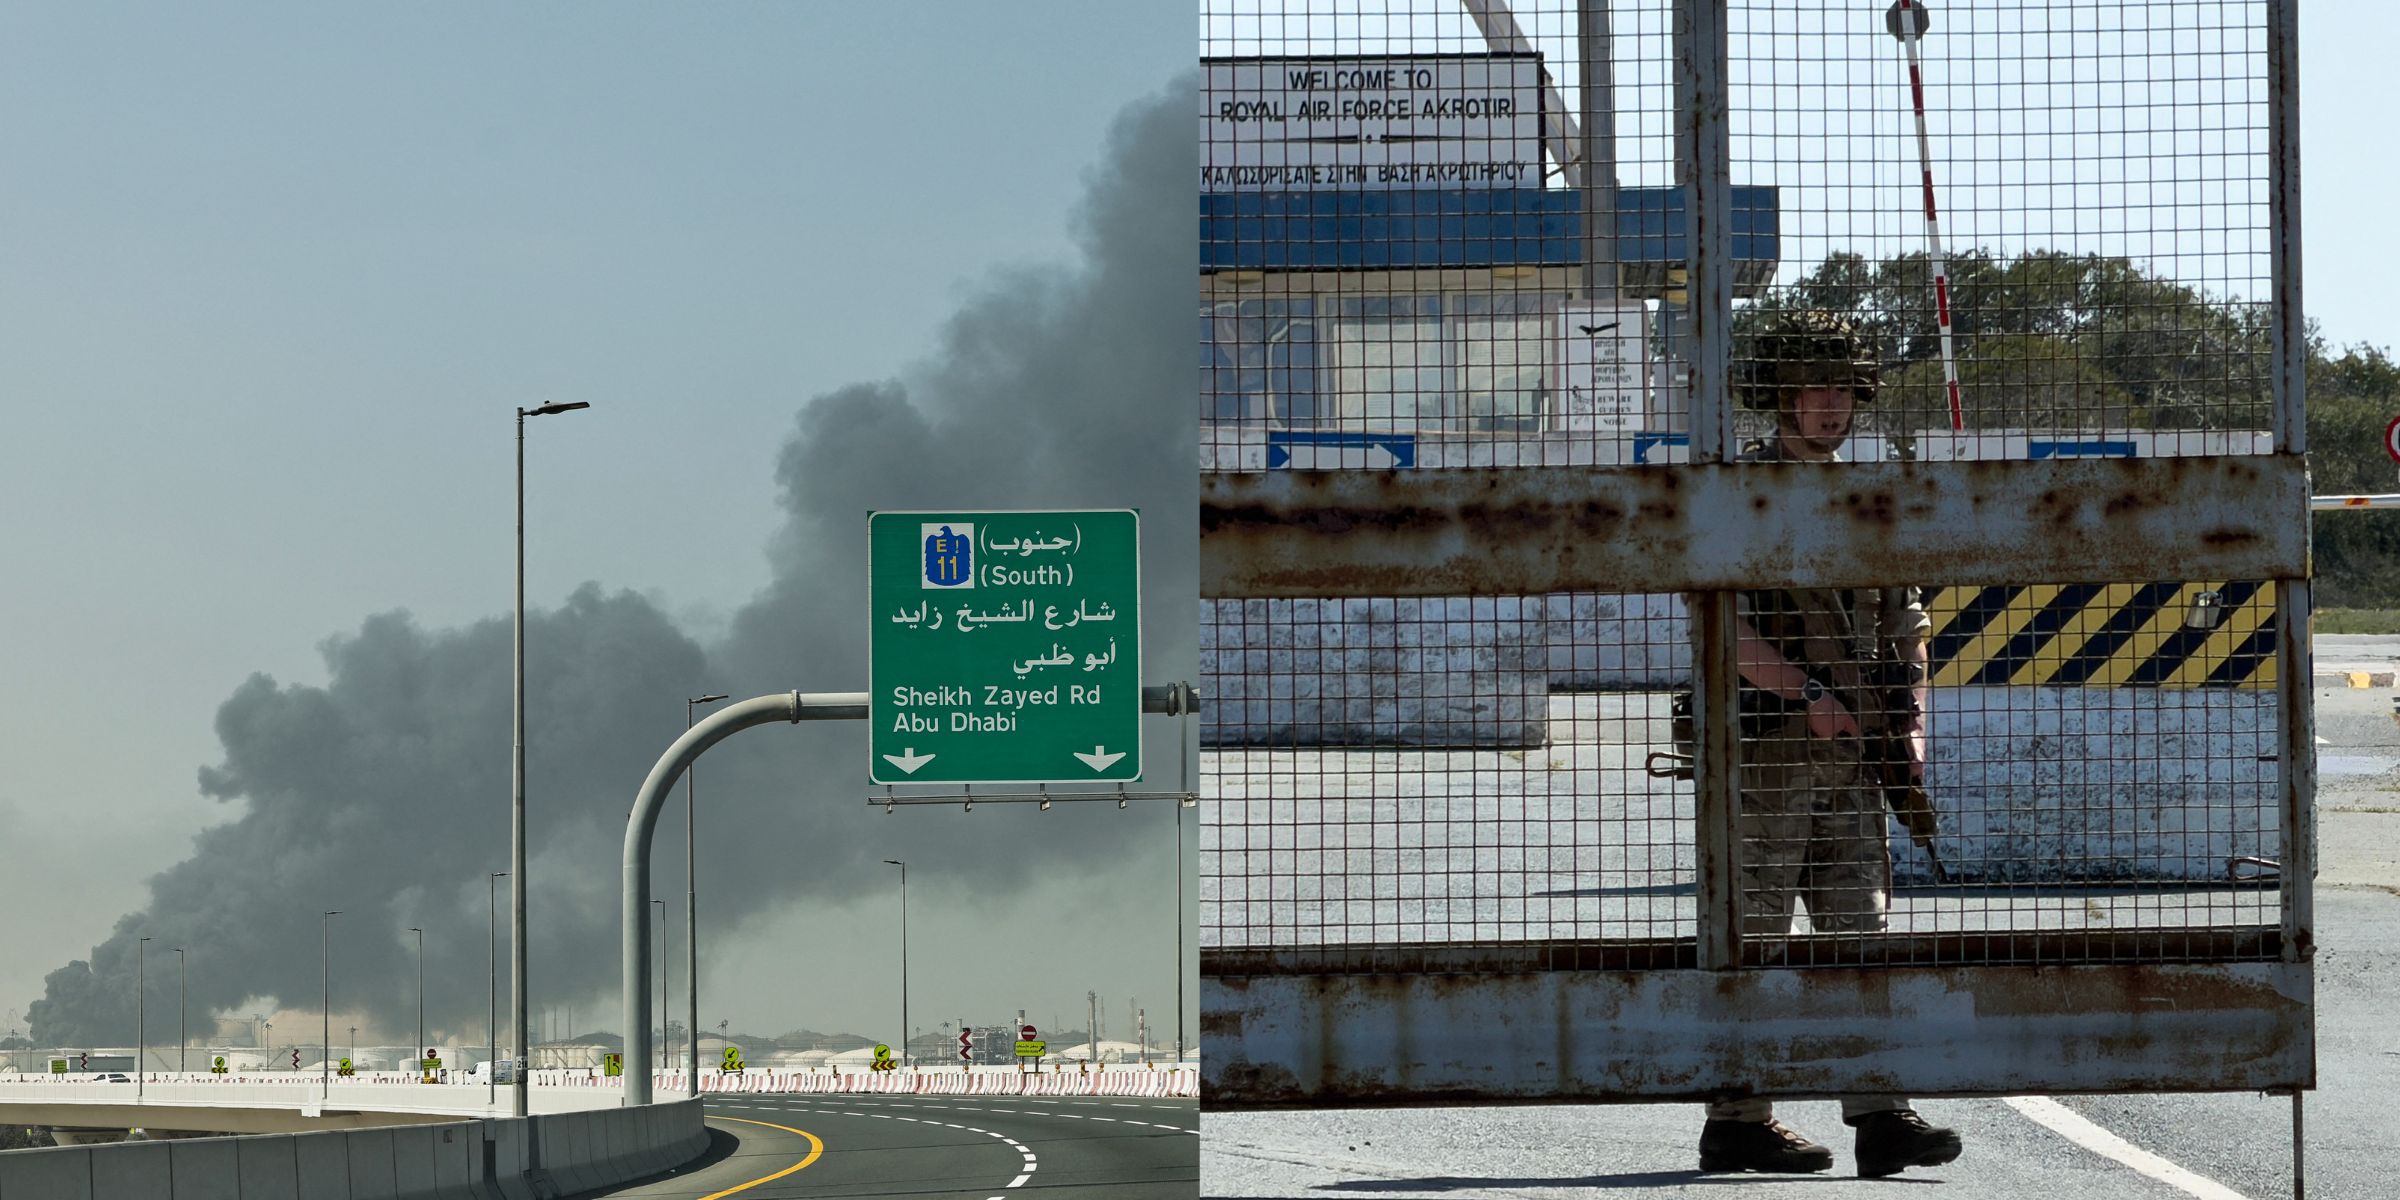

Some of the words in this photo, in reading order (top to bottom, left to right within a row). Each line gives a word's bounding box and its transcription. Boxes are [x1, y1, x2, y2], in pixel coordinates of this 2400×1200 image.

[1290, 69, 1396, 90] WELCOME
[1404, 69, 1432, 89] TO
[1220, 100, 1285, 122] ROYAL
[1297, 100, 1331, 122] AIR
[1342, 99, 1410, 121] FORCE
[980, 522, 1082, 557] (جنوب)
[937, 555, 958, 580] 11
[980, 563, 1074, 588] (South)
[892, 600, 943, 630] زايد
[955, 599, 1035, 632] الشيخ
[1044, 599, 1116, 630] شارع
[1013, 643, 1075, 680] ظبي
[1082, 636, 1116, 672] أبو
[893, 685, 972, 707] Sheikh
[984, 685, 1058, 710] Zayed
[1070, 684, 1101, 705] Rd
[893, 712, 939, 733] Abu
[951, 711, 1017, 732] Dhabi
